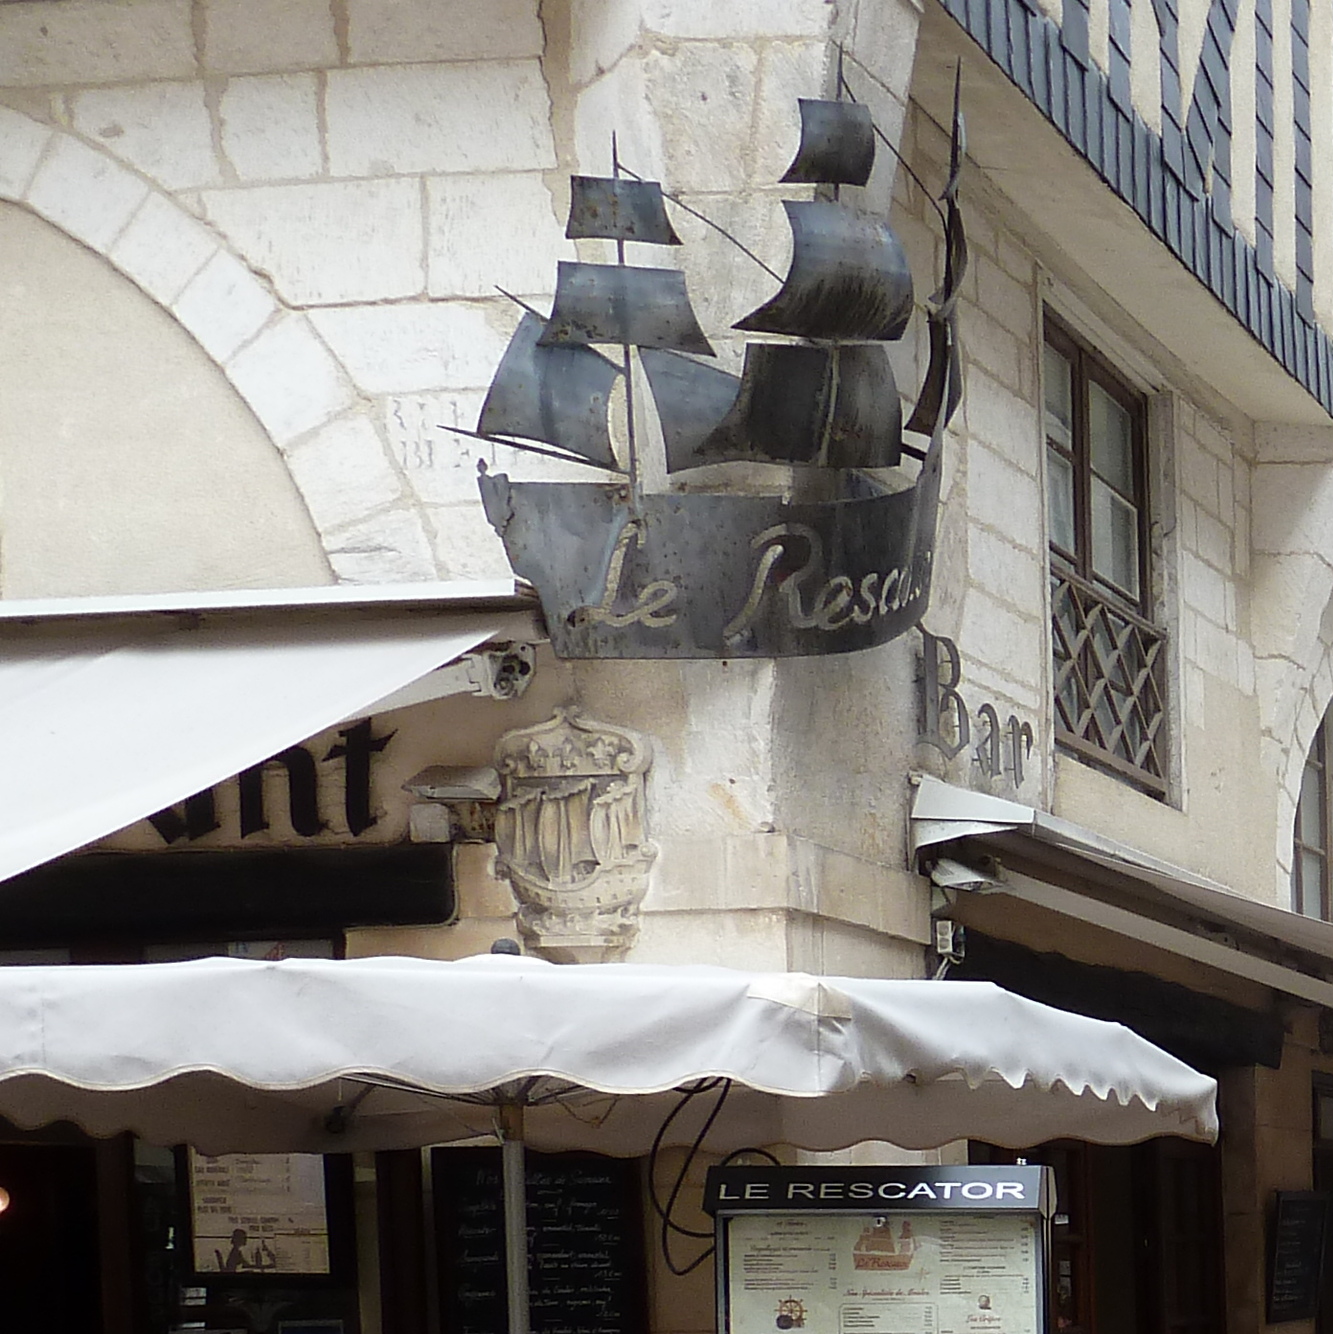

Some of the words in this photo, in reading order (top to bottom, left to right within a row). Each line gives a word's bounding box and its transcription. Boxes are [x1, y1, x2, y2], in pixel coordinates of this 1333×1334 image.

[566, 519, 678, 628] Le
[916, 623, 1034, 789] Bar
[719, 1183, 771, 1200] LE
[786, 1181, 1026, 1200] RESCATOR
